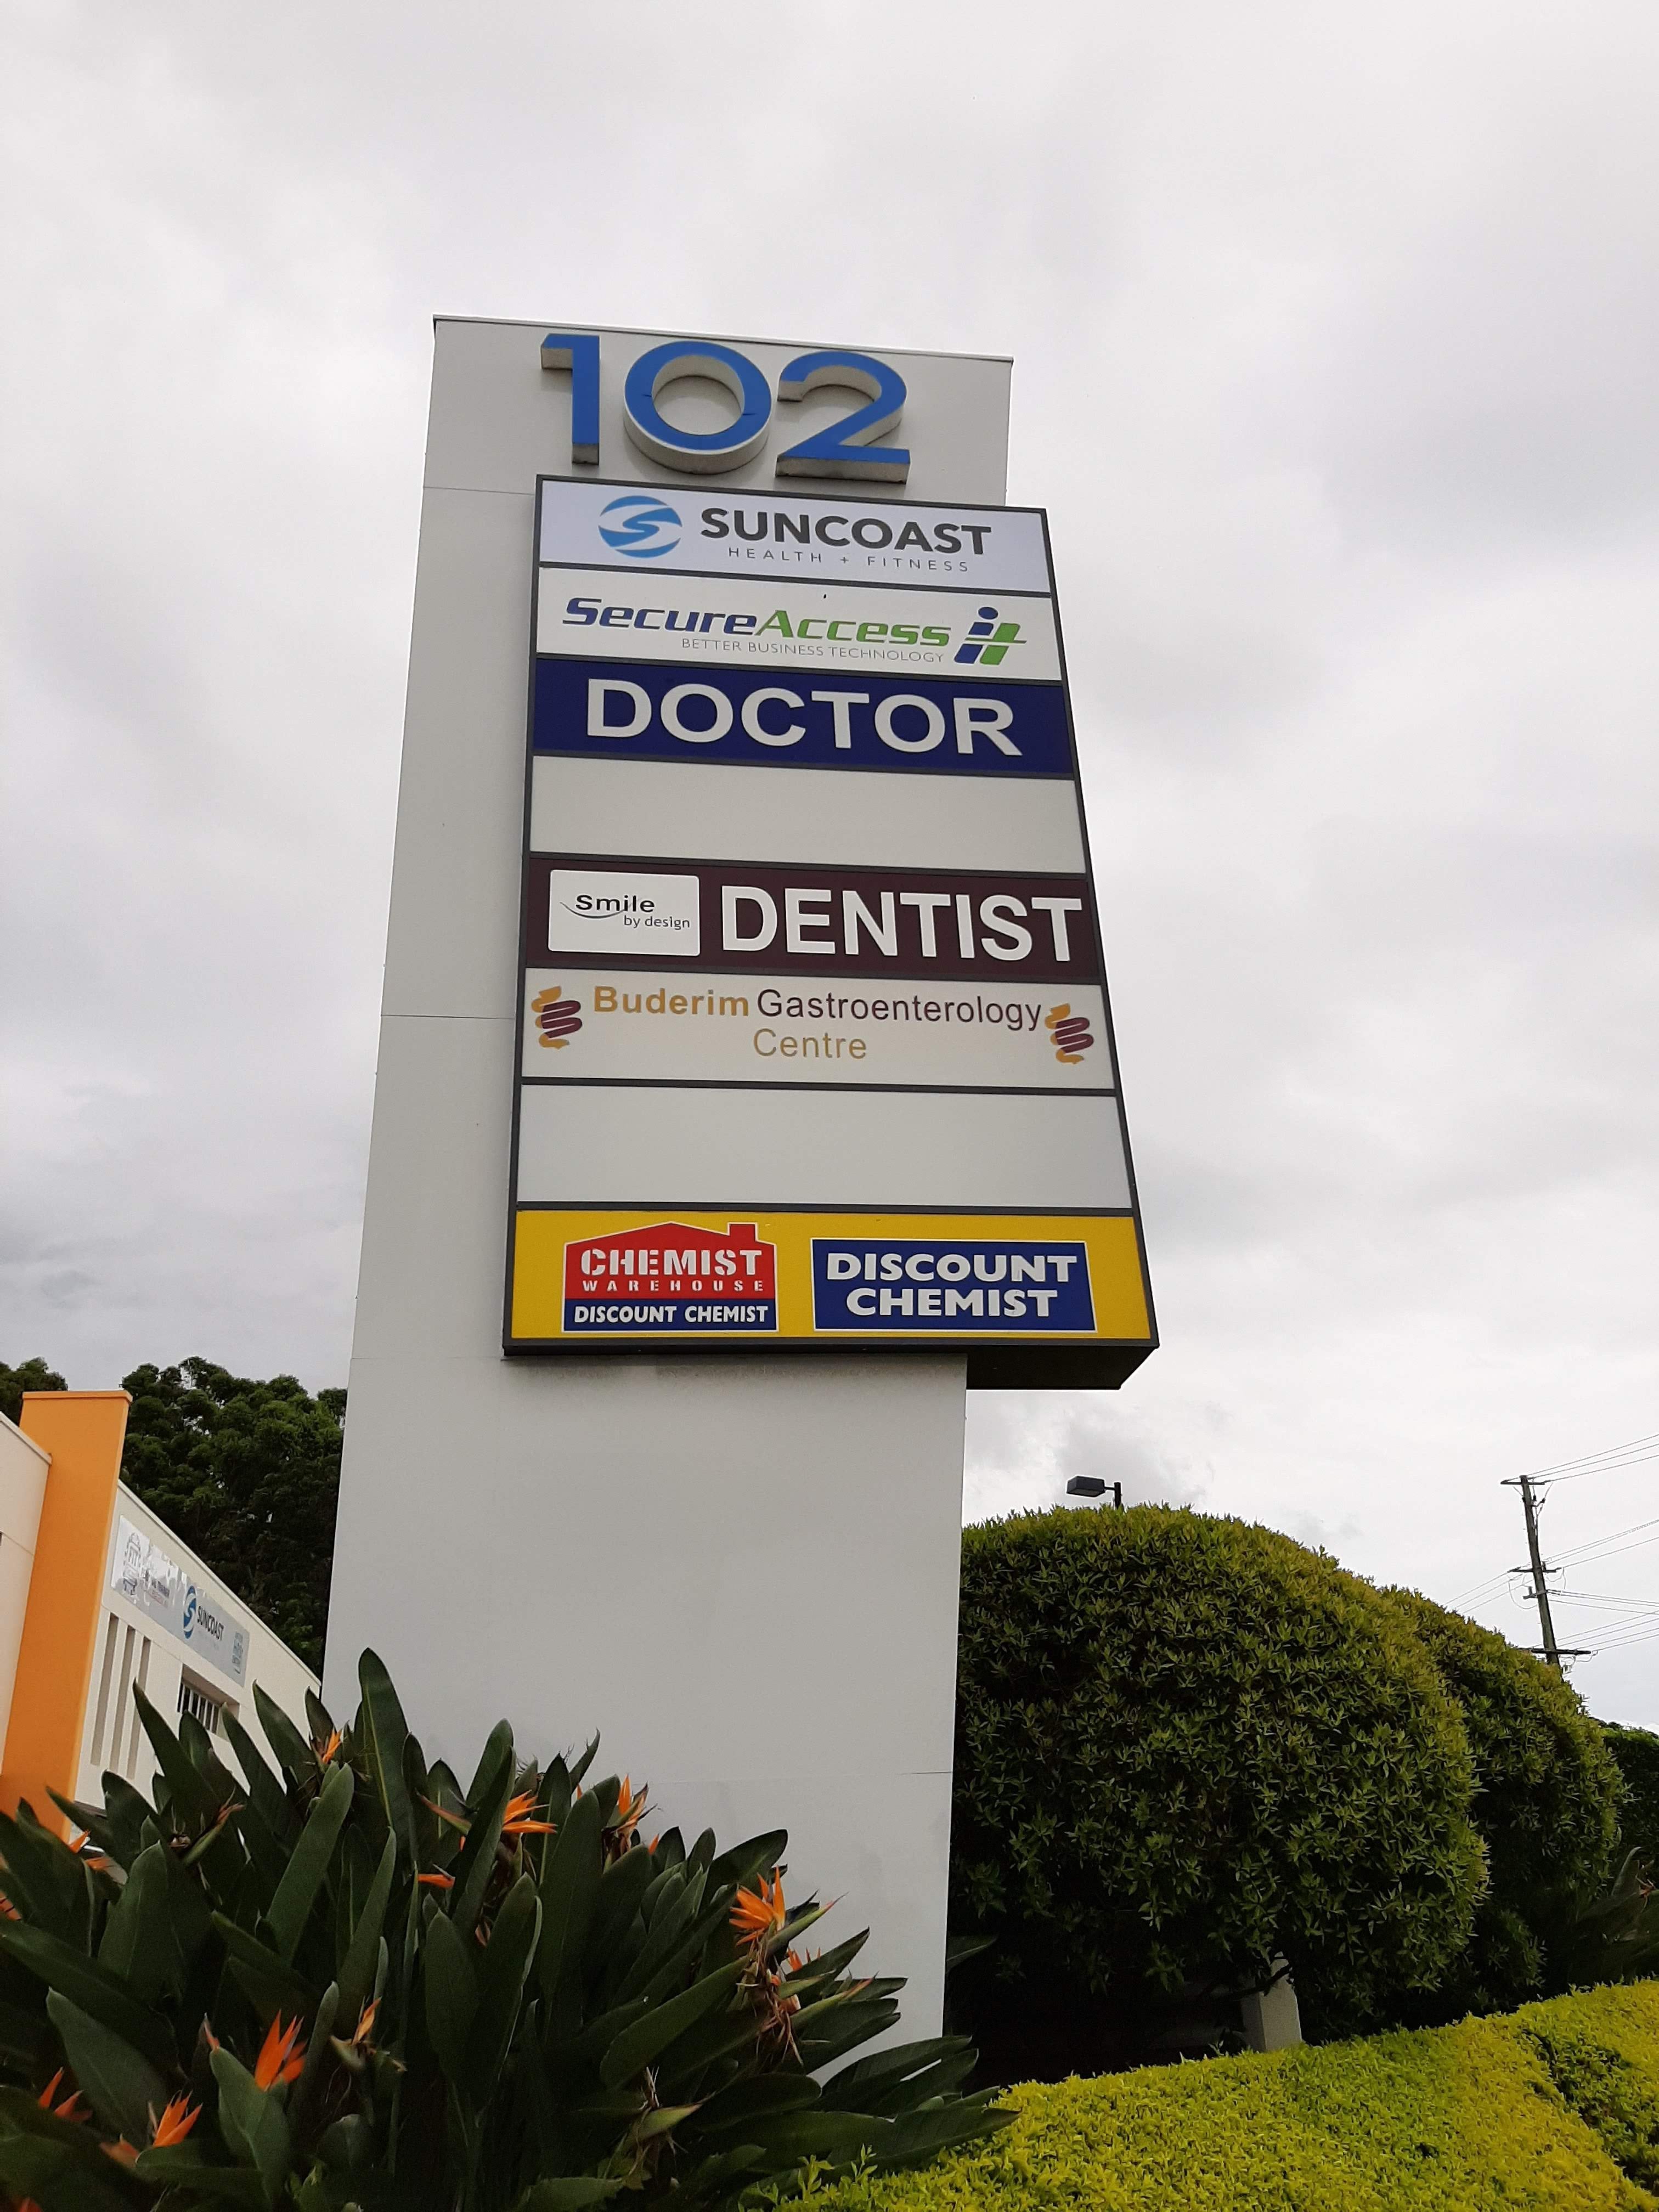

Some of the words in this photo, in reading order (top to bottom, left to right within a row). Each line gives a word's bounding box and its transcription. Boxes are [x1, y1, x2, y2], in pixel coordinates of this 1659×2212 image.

[541, 332, 911, 484] 102
[701, 507, 991, 555] SUNCOAST
[729, 547, 821, 563] HEALTH
[867, 556, 968, 572] FITNESS
[562, 597, 951, 647] SecureAccess
[682, 637, 742, 652] BETTER
[748, 642, 824, 657] BUSINESS
[828, 646, 944, 663] TECHNOLOGY
[587, 678, 1022, 757] DOCTOR
[575, 894, 655, 913] Smile
[624, 915, 641, 928] by
[645, 916, 690, 930] design
[721, 884, 1082, 962] DENTIST
[593, 985, 749, 1017] Buderim
[757, 989, 1042, 1031] Gastroenterology
[753, 1028, 868, 1059] Centre
[580, 1248, 763, 1277] CHEMIST
[826, 1252, 1077, 1283] DISCOUNT
[582, 1279, 764, 1292] WAREHOUSE
[574, 1305, 678, 1323] DISCOUNT
[684, 1305, 769, 1323] CHEMIST
[846, 1287, 1058, 1317] CHEMIST
[197, 1605, 224, 1641] SUNCOAST
